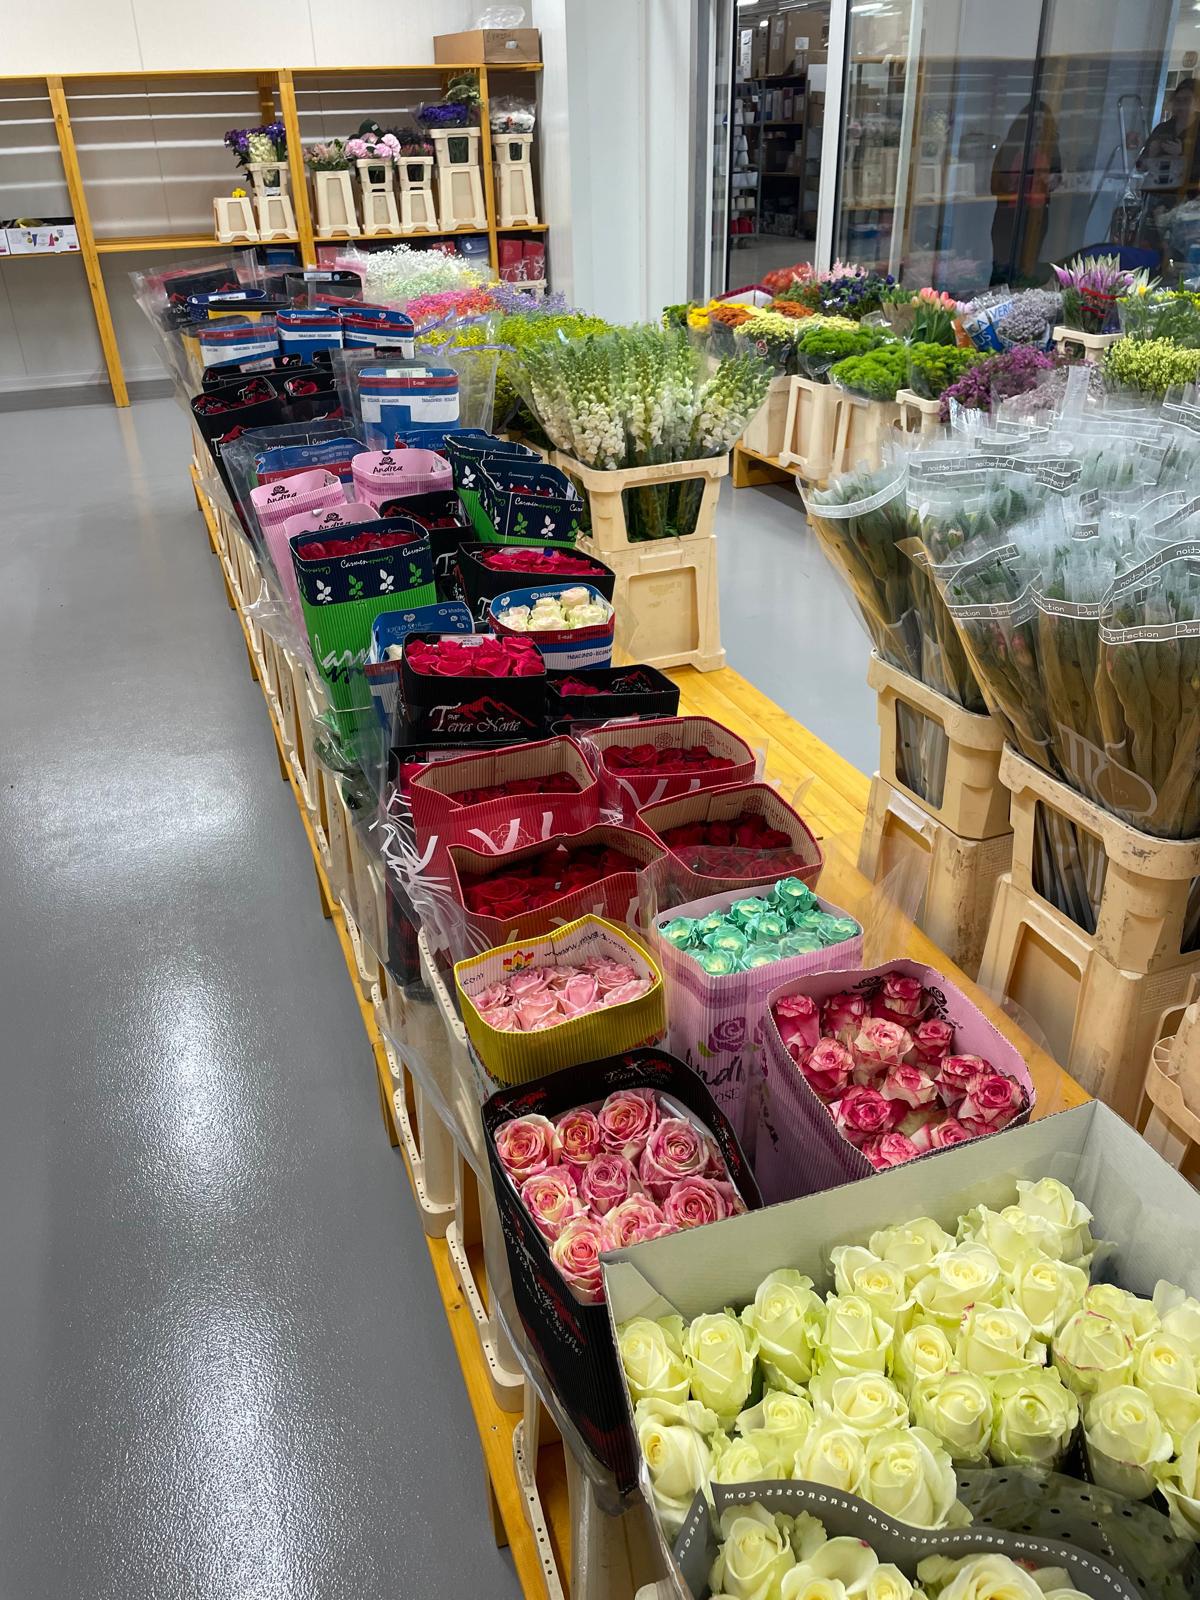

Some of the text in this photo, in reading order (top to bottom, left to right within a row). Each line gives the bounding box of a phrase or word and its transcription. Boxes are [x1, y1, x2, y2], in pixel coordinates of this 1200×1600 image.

[372, 465, 404, 474] Andrea
[1102, 628, 1159, 642] Perfection
[429, 702, 521, 732] Terra Norte
